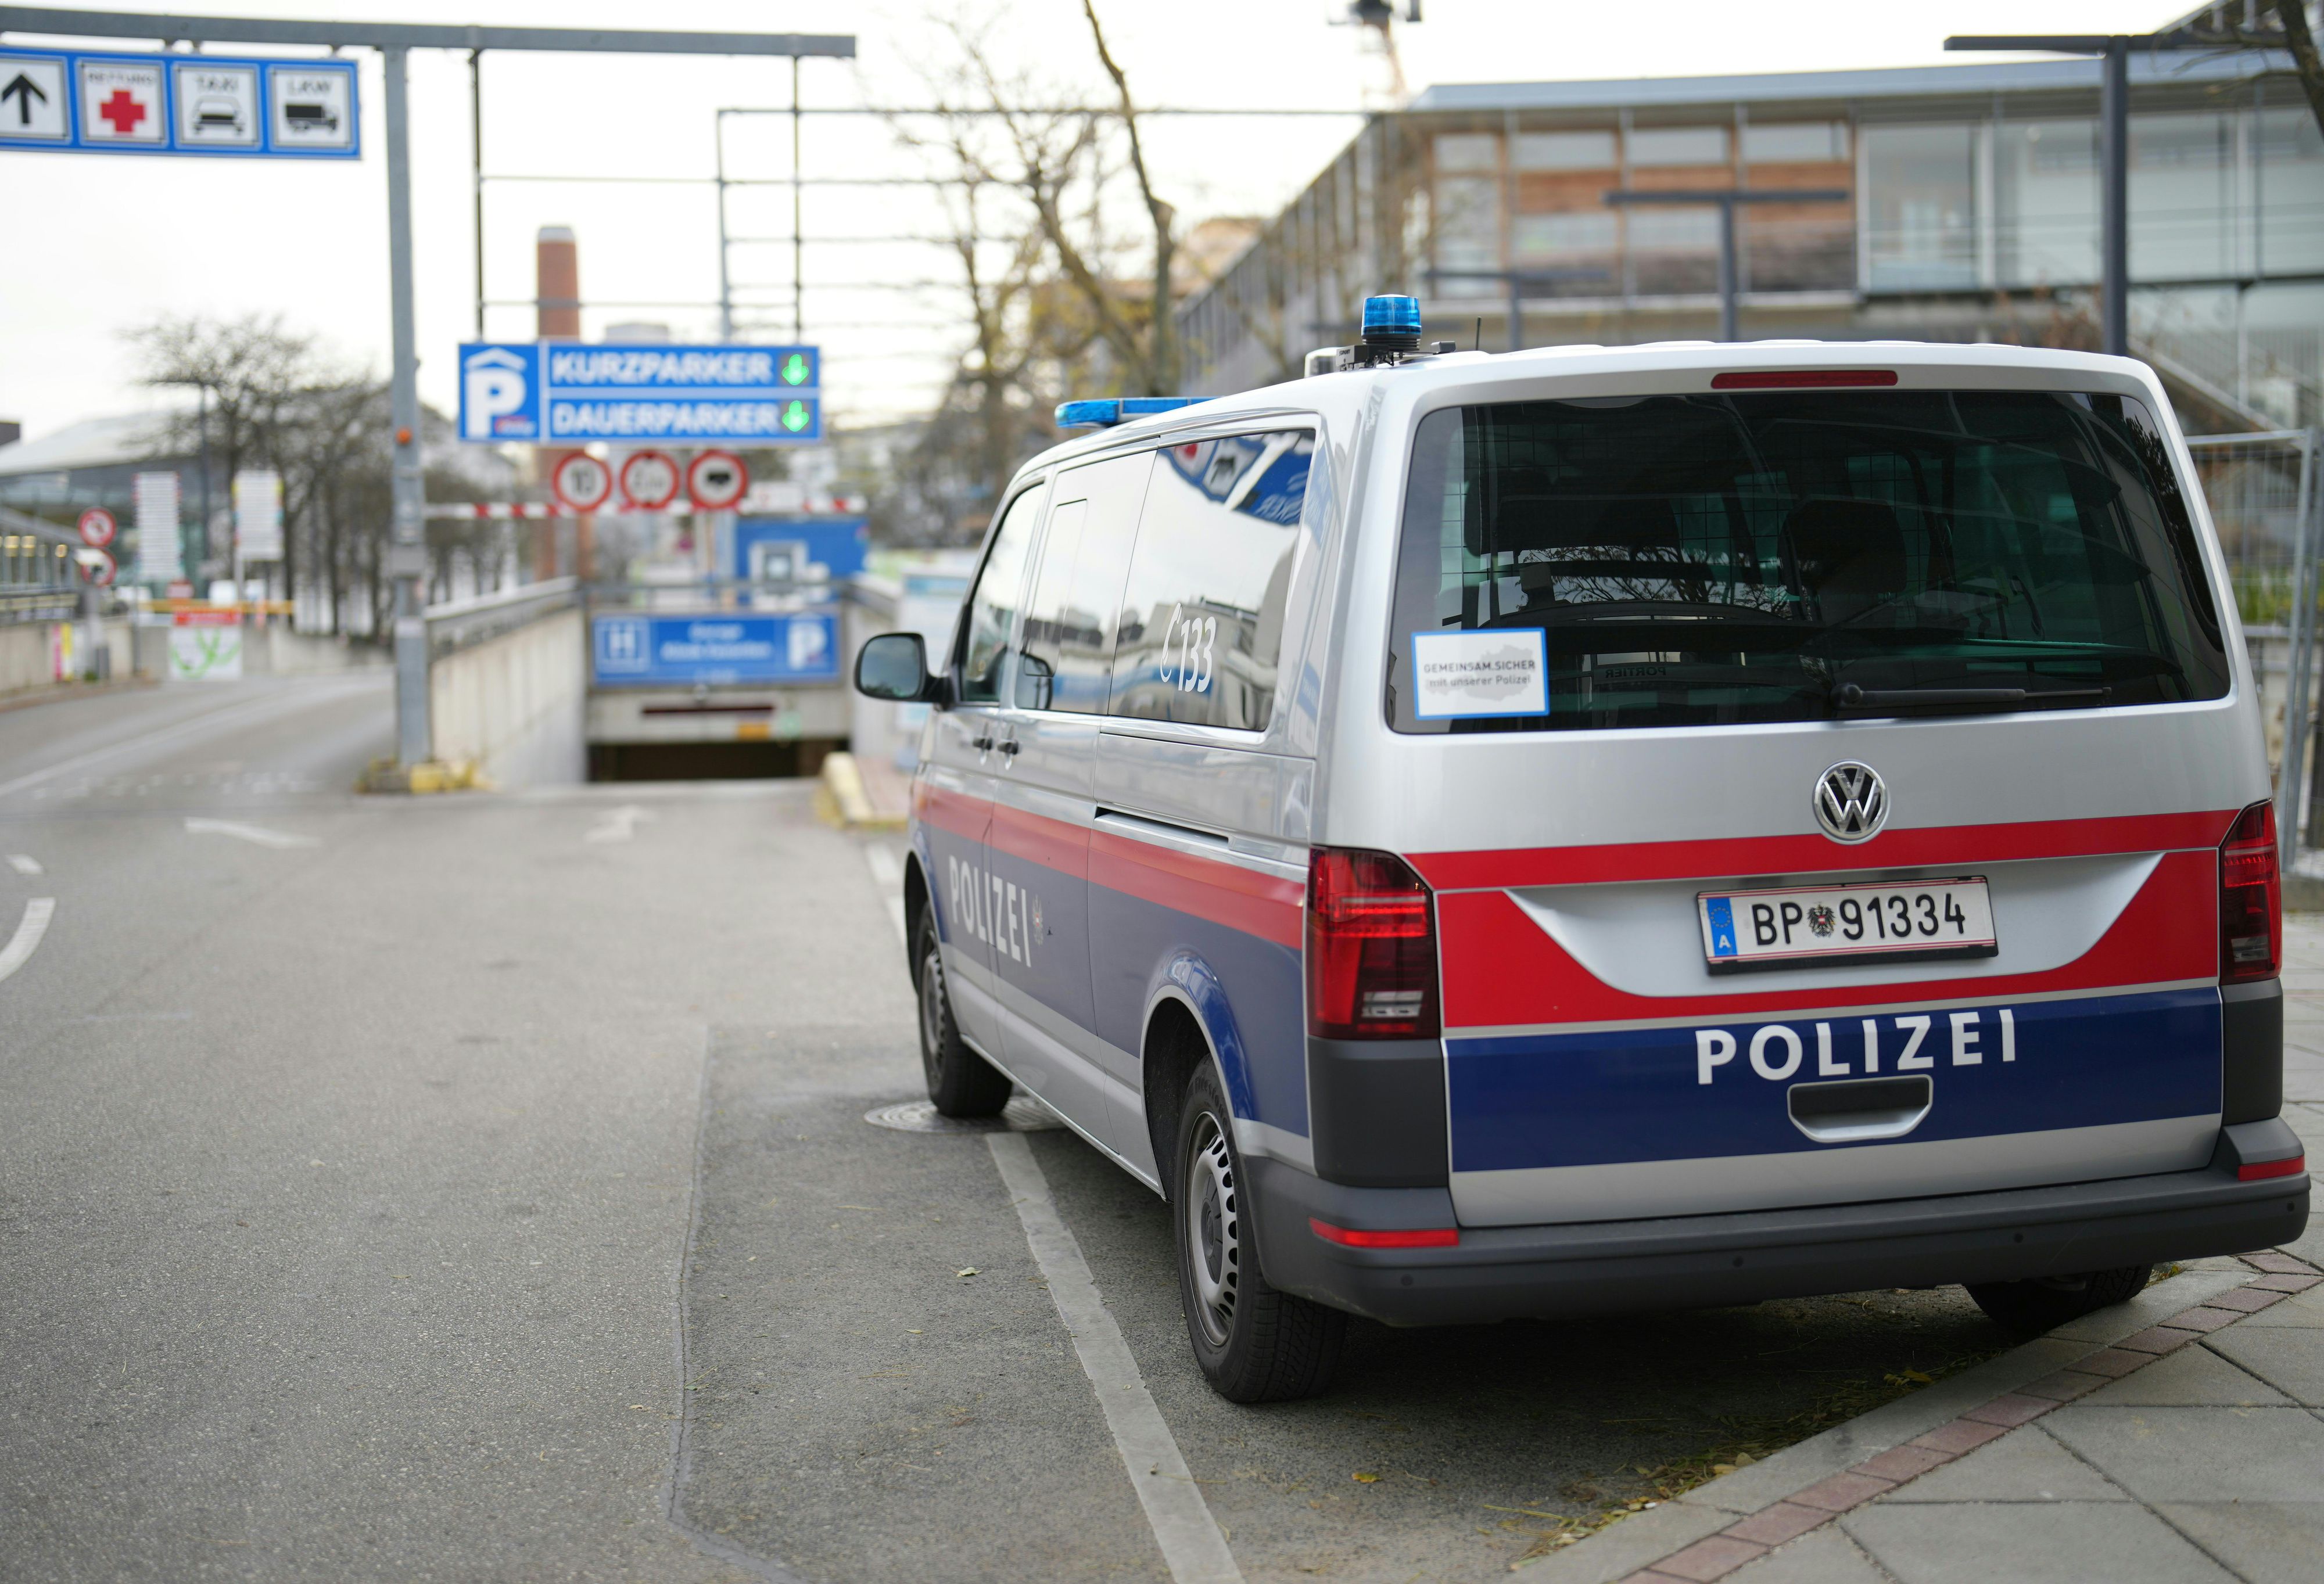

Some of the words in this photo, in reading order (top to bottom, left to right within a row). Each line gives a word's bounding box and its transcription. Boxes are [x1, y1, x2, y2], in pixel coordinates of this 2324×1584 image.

[193, 74, 239, 92] TAXI
[287, 80, 332, 95] LKW
[551, 352, 773, 385] KURZPARKER
[467, 369, 526, 438] P
[551, 403, 779, 436] DAUERPARKER
[1178, 616, 1216, 692] 133
[1424, 660, 1536, 674] GEMEINSAM.SICHER
[1429, 678, 1447, 688] mit
[1450, 677, 1493, 687] unserer
[1495, 674, 1532, 685] Polizei
[949, 854, 1031, 968] POLIZEI
[1752, 901, 1803, 946] BP
[1839, 893, 1966, 941] 91334
[1718, 934, 1732, 949] A
[1695, 1009, 2016, 1085] POLIZEI
